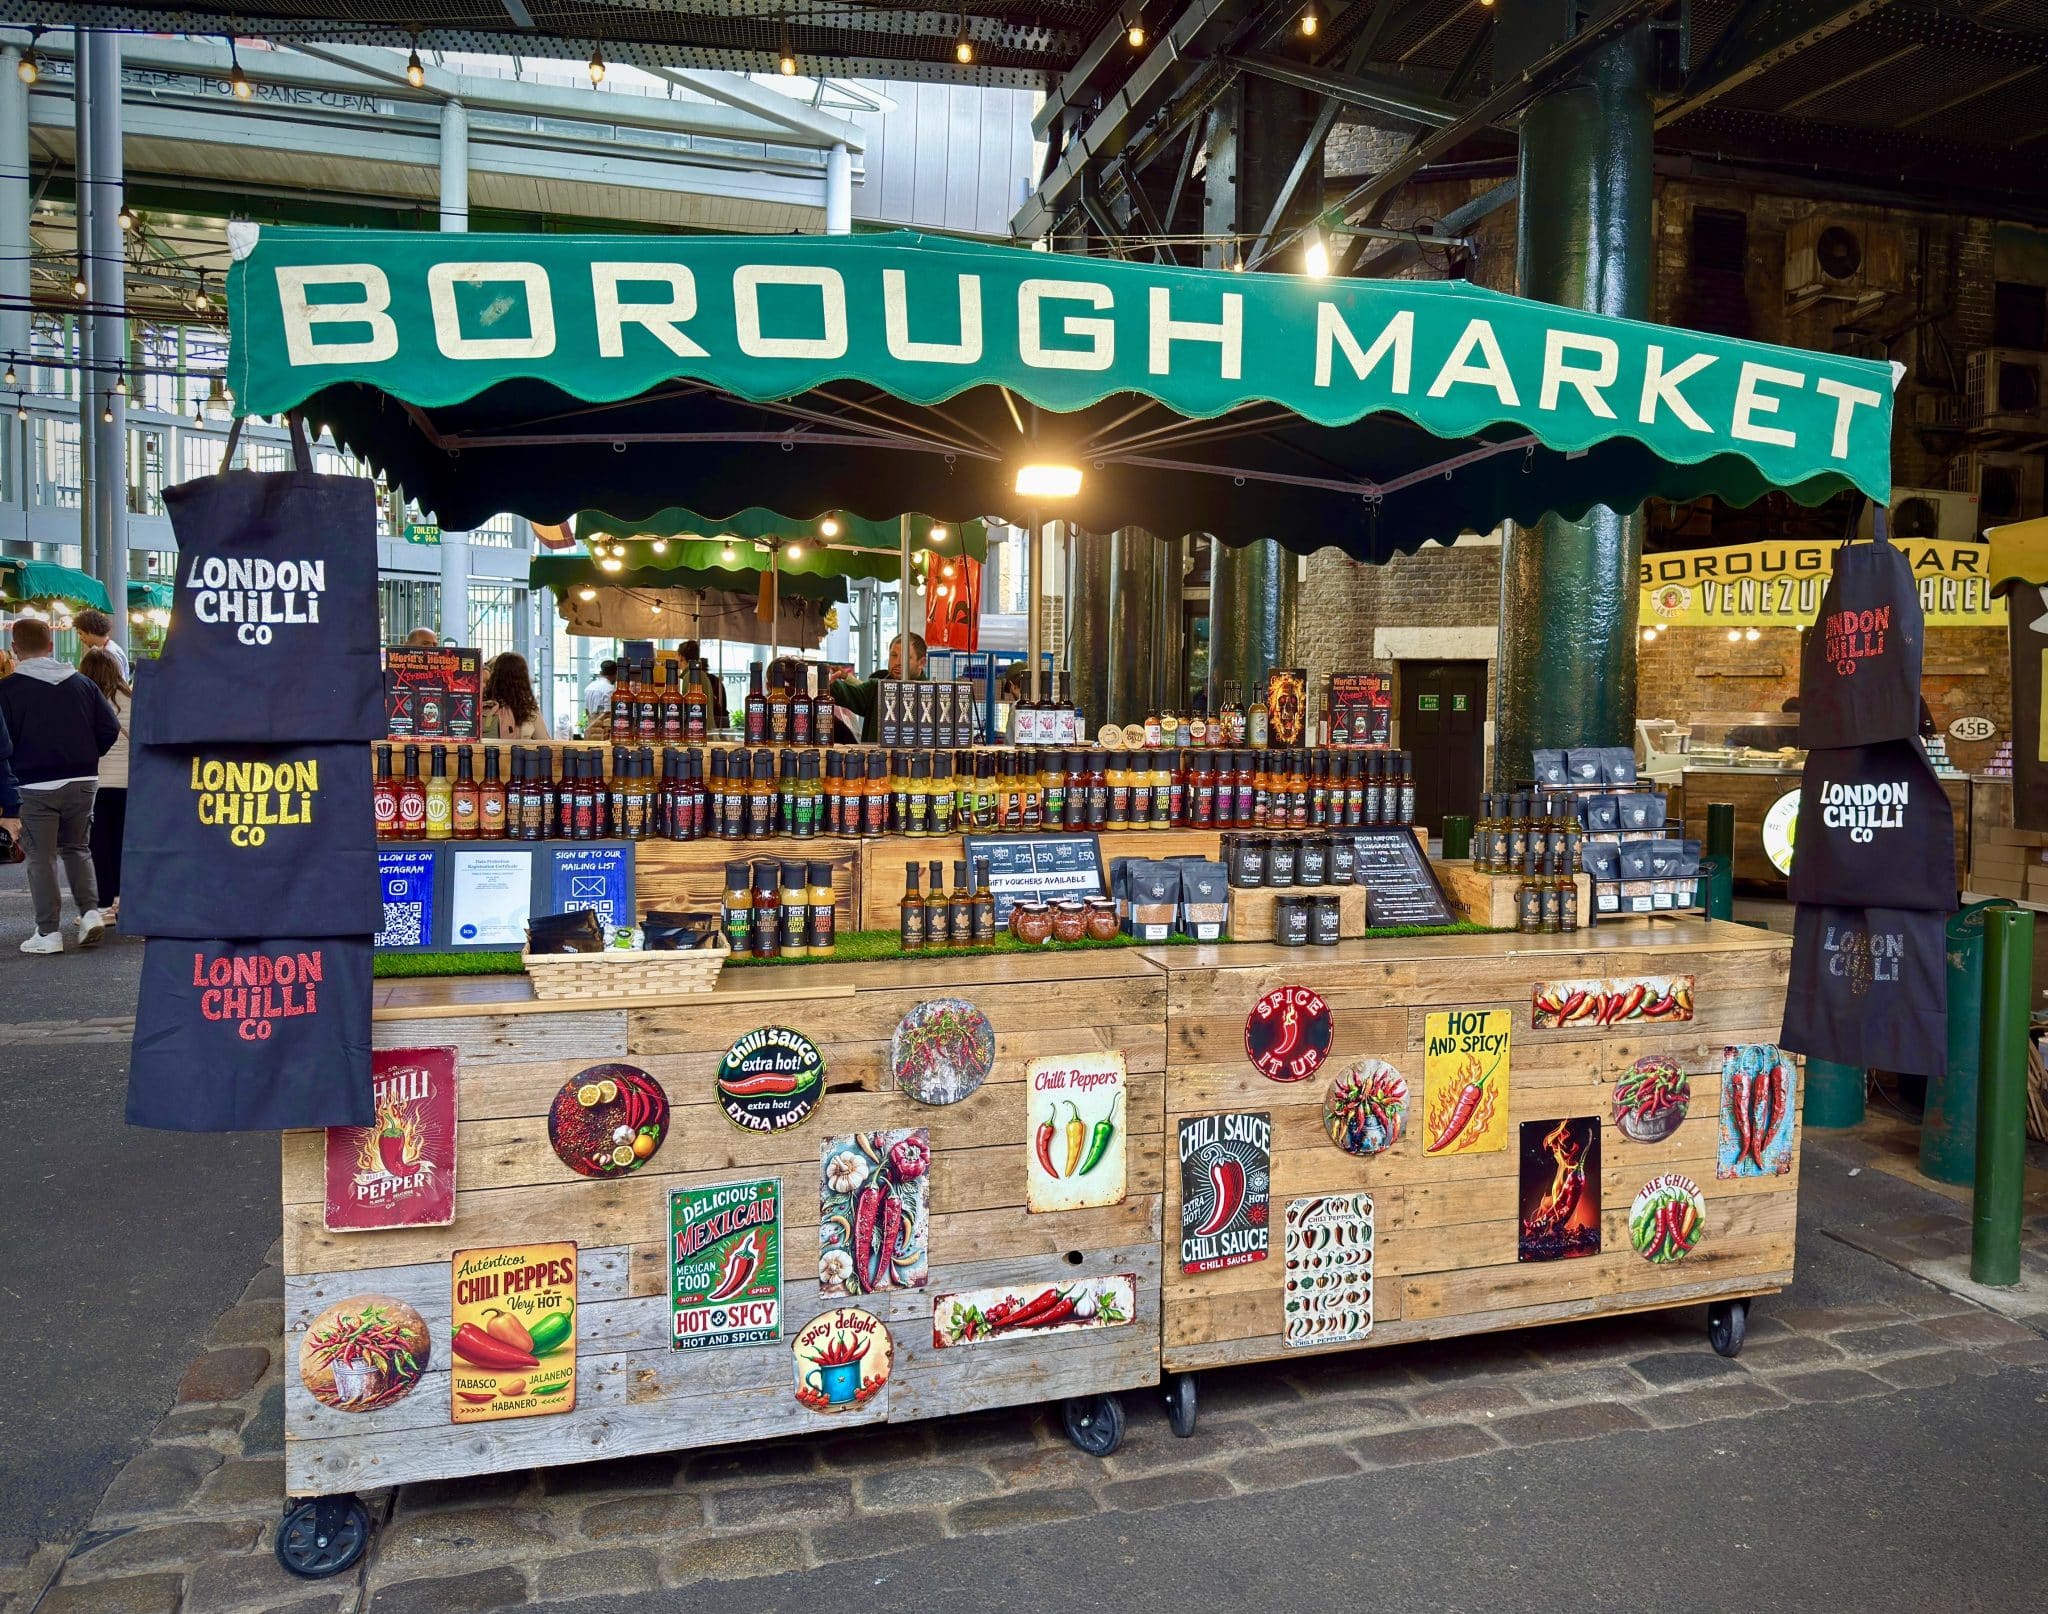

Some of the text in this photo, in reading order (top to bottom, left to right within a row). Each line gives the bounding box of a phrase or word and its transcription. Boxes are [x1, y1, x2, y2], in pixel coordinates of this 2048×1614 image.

[275, 262, 1882, 459] BOROUGH MARKET
[413, 526, 438, 535] TOILETS
[186, 555, 326, 591] LONDON
[1641, 550, 1837, 584] BOROUG
[1702, 579, 1823, 614] VENEZU
[237, 623, 273, 646] CO
[1836, 660, 1856, 675] CO
[1956, 722, 1989, 735] 45B
[191, 756, 319, 792] LONDON
[1819, 780, 1909, 806] LONDON
[230, 825, 266, 847] CO
[1850, 827, 1873, 843] CO
[405, 853, 417, 861] US
[418, 853, 433, 861] ON
[555, 851, 576, 859] SIGN
[1015, 853, 1032, 863] £25
[1036, 852, 1054, 863] £50
[1078, 851, 1095, 861] £50
[561, 862, 616, 871] MAILING LIST
[1005, 877, 1042, 886] VOUCHERS
[1045, 875, 1086, 885] AVAILABLE
[192, 951, 323, 986] LONDON
[1257, 989, 1324, 1019] SPICE
[238, 1019, 273, 1040] CO
[1448, 1011, 1491, 1035] HOT
[1428, 1032, 1508, 1057] AND SPICY!
[741, 1052, 801, 1072] extra hot!
[1258, 1049, 1317, 1076] IT UP
[373, 1070, 429, 1111] HILLI
[1035, 1069, 1118, 1093] Chilli Peppers
[726, 1100, 811, 1130] EXTRA HOT!
[747, 1099, 791, 1110] extra hot!
[1179, 1113, 1271, 1163] CHILI SAUCE
[357, 1172, 425, 1201] PEPPER
[1639, 1177, 1662, 1200] THE
[683, 1186, 758, 1225] DELICIOUS
[1183, 1196, 1205, 1216] EXTRA
[1249, 1193, 1269, 1203] HOT!
[1183, 1209, 1202, 1227] HOT!
[1328, 1214, 1356, 1222] PEPPERS
[675, 1197, 775, 1264] MEXICAN
[1182, 1228, 1268, 1262] CHILI SAUCE
[457, 1254, 526, 1279] Auténticos
[676, 1261, 716, 1276] MEXICAN
[1200, 1253, 1253, 1271] CHILI SAUCE
[457, 1257, 574, 1305] CHILI PEPPES
[677, 1273, 711, 1292] FOOD
[506, 1295, 562, 1315] Very HOT
[677, 1309, 711, 1334] HOT
[712, 1311, 725, 1326] &
[801, 1310, 877, 1347] spicy delight
[682, 1329, 768, 1349] HOT AND SPICY!
[1316, 1334, 1347, 1344] PEPPERS
[456, 1378, 497, 1389] TABASCO
[528, 1367, 573, 1385] JALANENO
[491, 1398, 538, 1412] HABANERO
